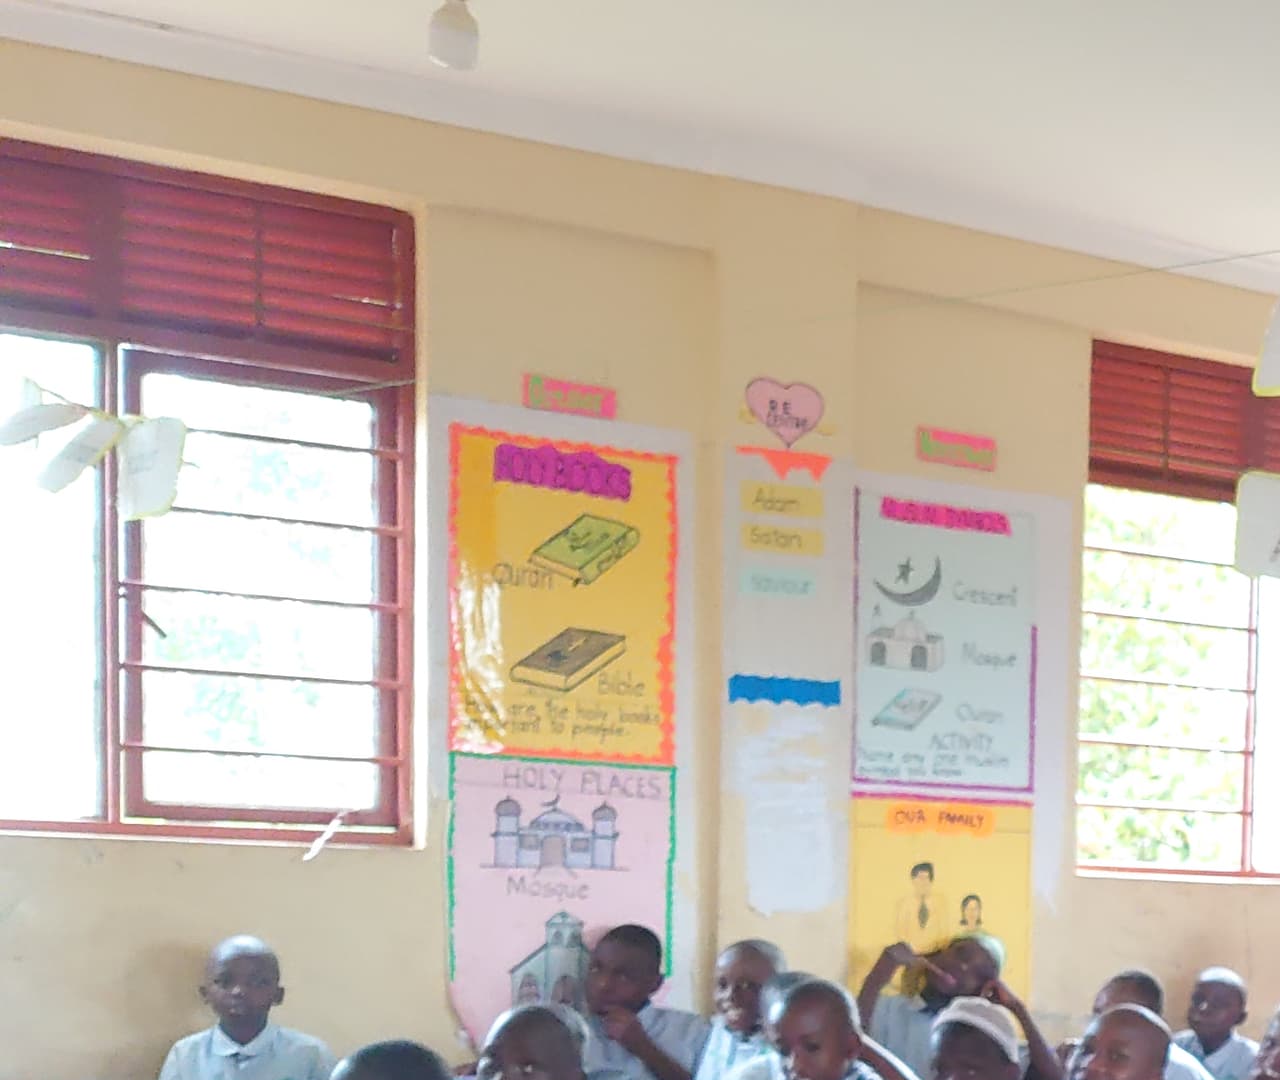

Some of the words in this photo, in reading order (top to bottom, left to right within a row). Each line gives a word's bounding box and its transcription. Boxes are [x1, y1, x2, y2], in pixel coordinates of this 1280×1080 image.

[503, 767, 563, 793] HOLY
[580, 770, 662, 799] PLACES
[507, 876, 591, 902] Mosque
